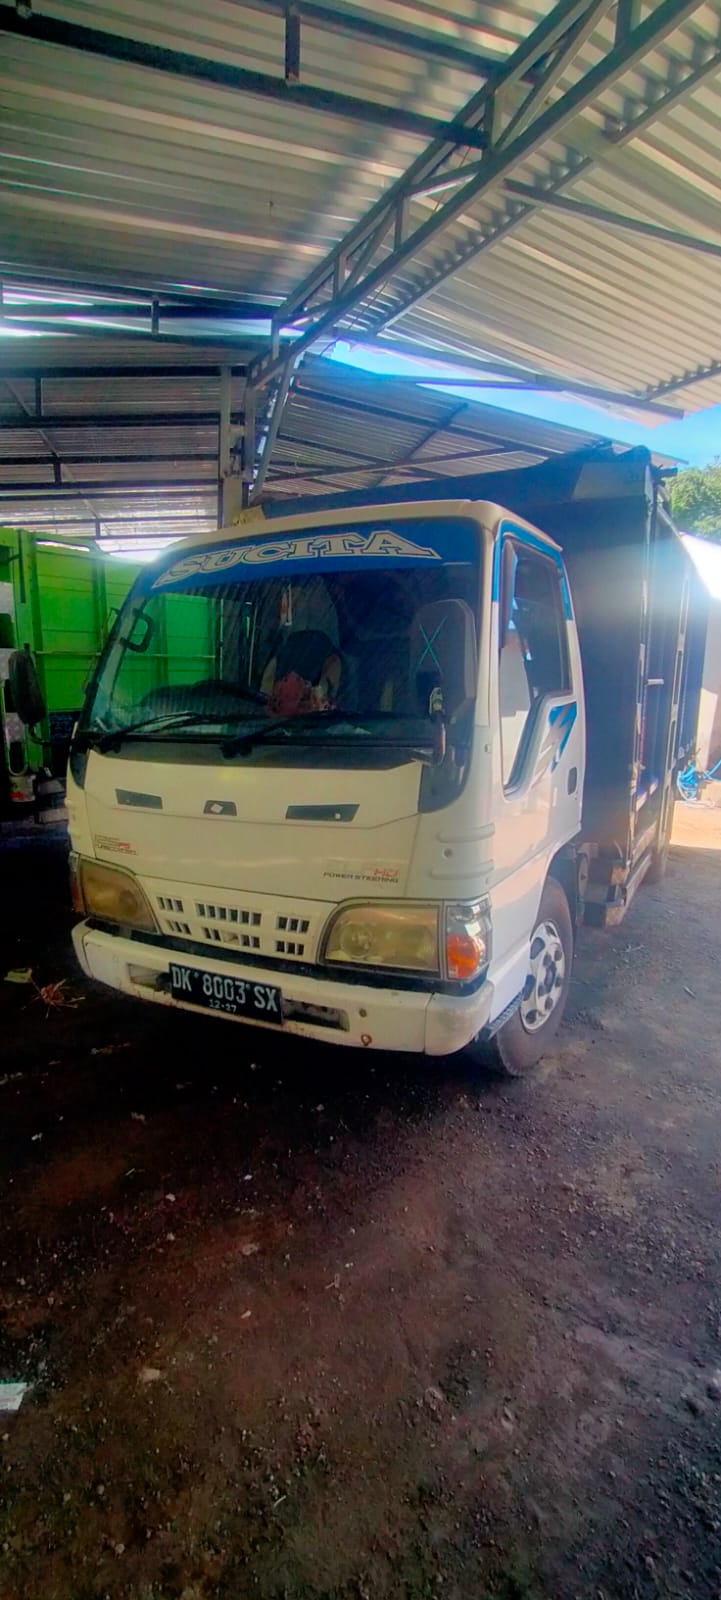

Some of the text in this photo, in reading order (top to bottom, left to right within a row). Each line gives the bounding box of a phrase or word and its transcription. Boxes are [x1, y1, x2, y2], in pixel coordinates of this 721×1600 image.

[152, 530, 441, 589] SUCITA
[323, 872, 399, 883] POWER STEERING
[171, 966, 278, 1012] DK 8003 SX
